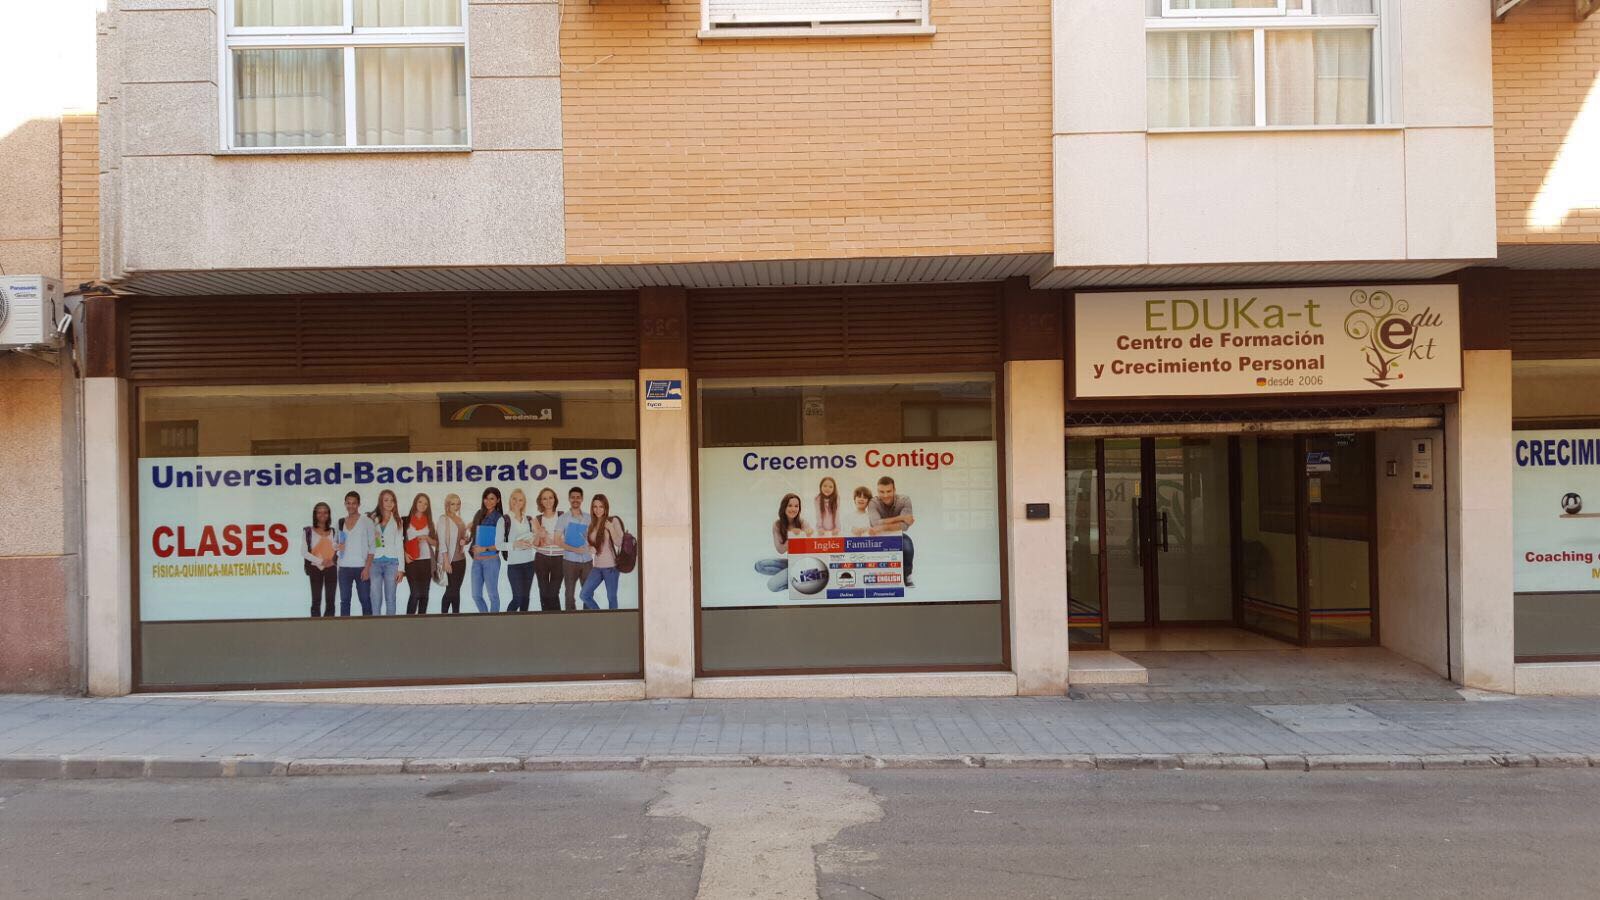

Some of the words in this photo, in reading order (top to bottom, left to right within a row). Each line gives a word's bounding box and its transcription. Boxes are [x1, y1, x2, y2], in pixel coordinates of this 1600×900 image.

[1145, 297, 1323, 331] EDUKa-t
[1116, 335, 1183, 350] Centro
[1189, 333, 1213, 348] de
[1220, 330, 1325, 348] Formación
[1093, 363, 1105, 378] y
[1111, 358, 1232, 375] Crecimiento
[1239, 354, 1325, 371] Personal
[1267, 376, 1295, 387] desde
[1298, 375, 1324, 386] 2006
[742, 452, 858, 471] Crecemos
[864, 448, 954, 470] Contigo
[152, 523, 289, 558] CLASES
[814, 541, 840, 551] Inglés
[846, 540, 882, 549] Familiar
[1525, 551, 1593, 564] Coaching
